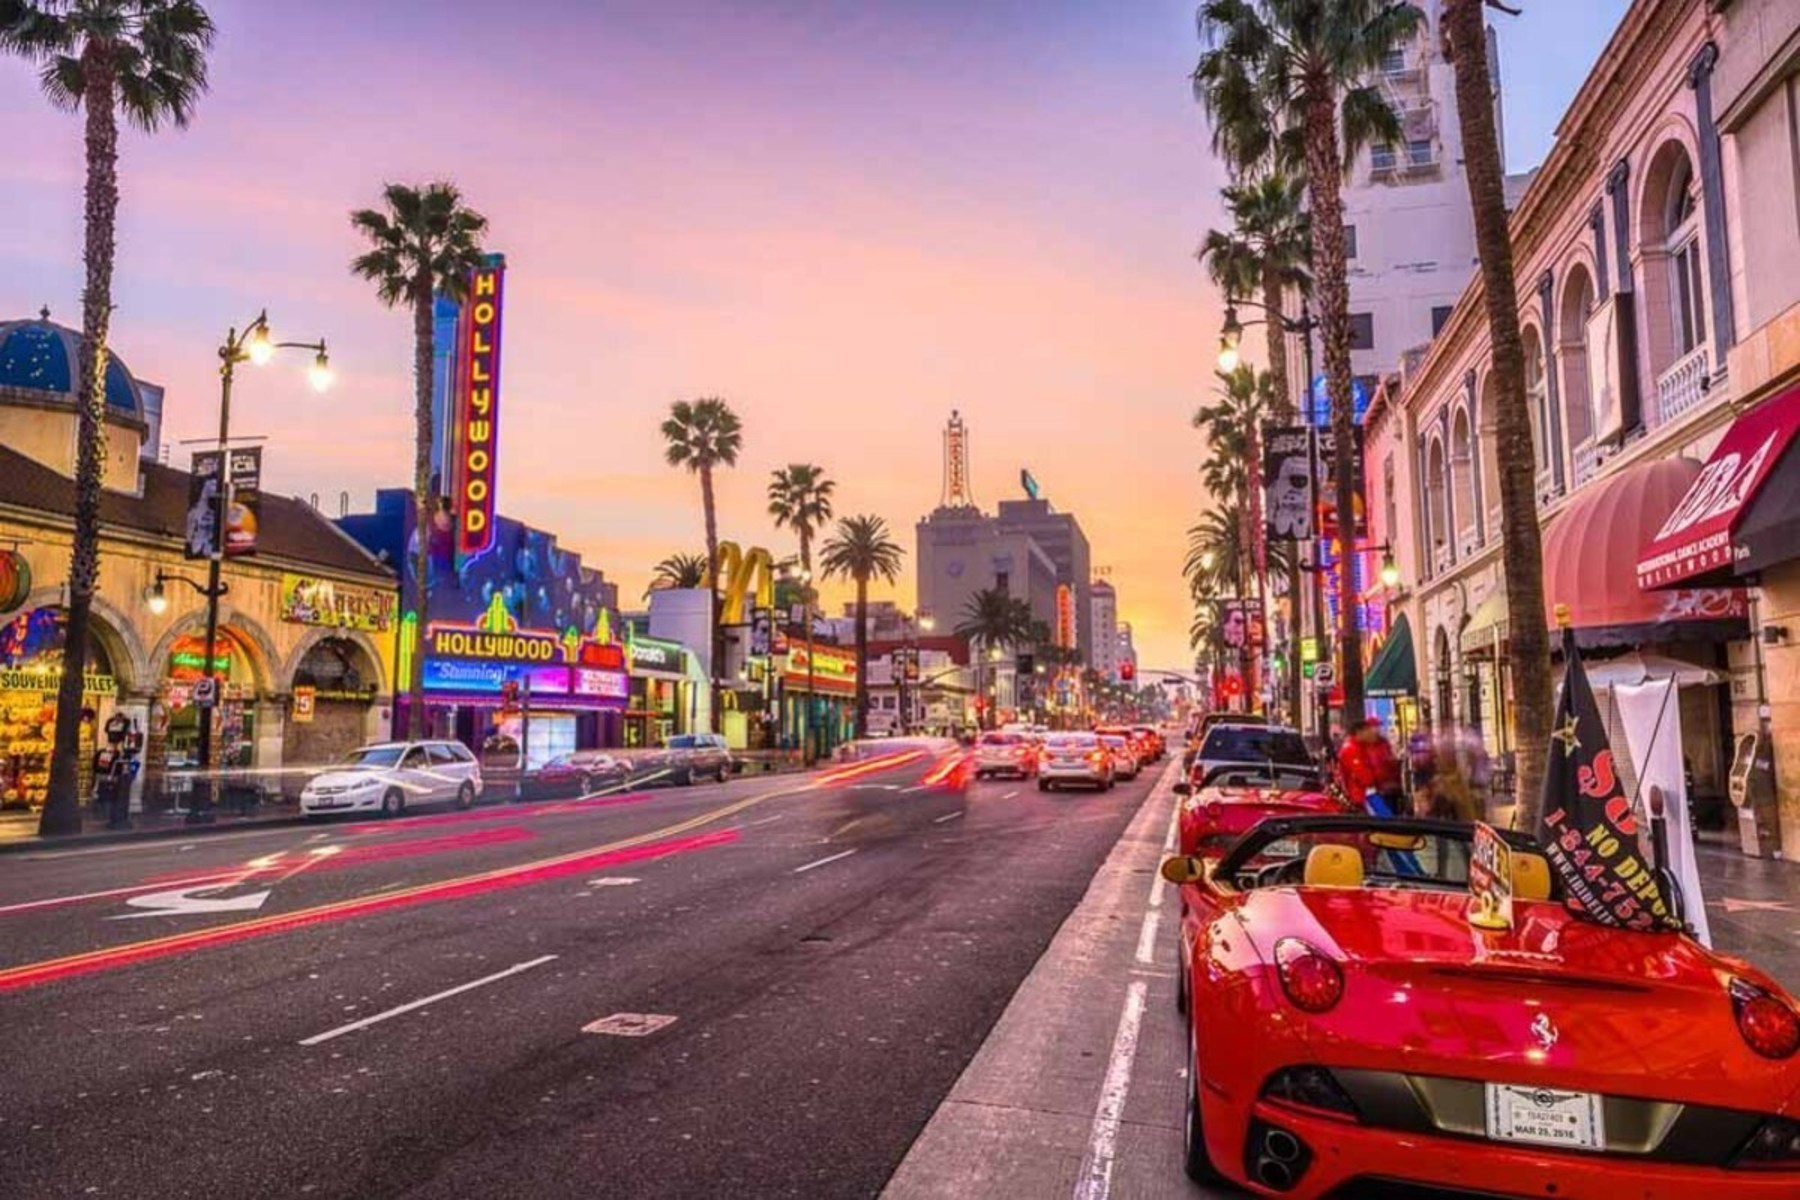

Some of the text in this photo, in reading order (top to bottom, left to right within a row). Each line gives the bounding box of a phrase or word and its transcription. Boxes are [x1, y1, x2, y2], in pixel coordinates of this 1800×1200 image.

[467, 274, 494, 532] HOLLYWOOD
[435, 632, 554, 661] HOLLYWOOD
[1585, 823, 1620, 858] NO
[1514, 1124, 1536, 1135] MAR
[1552, 1128, 1575, 1139] 2016
